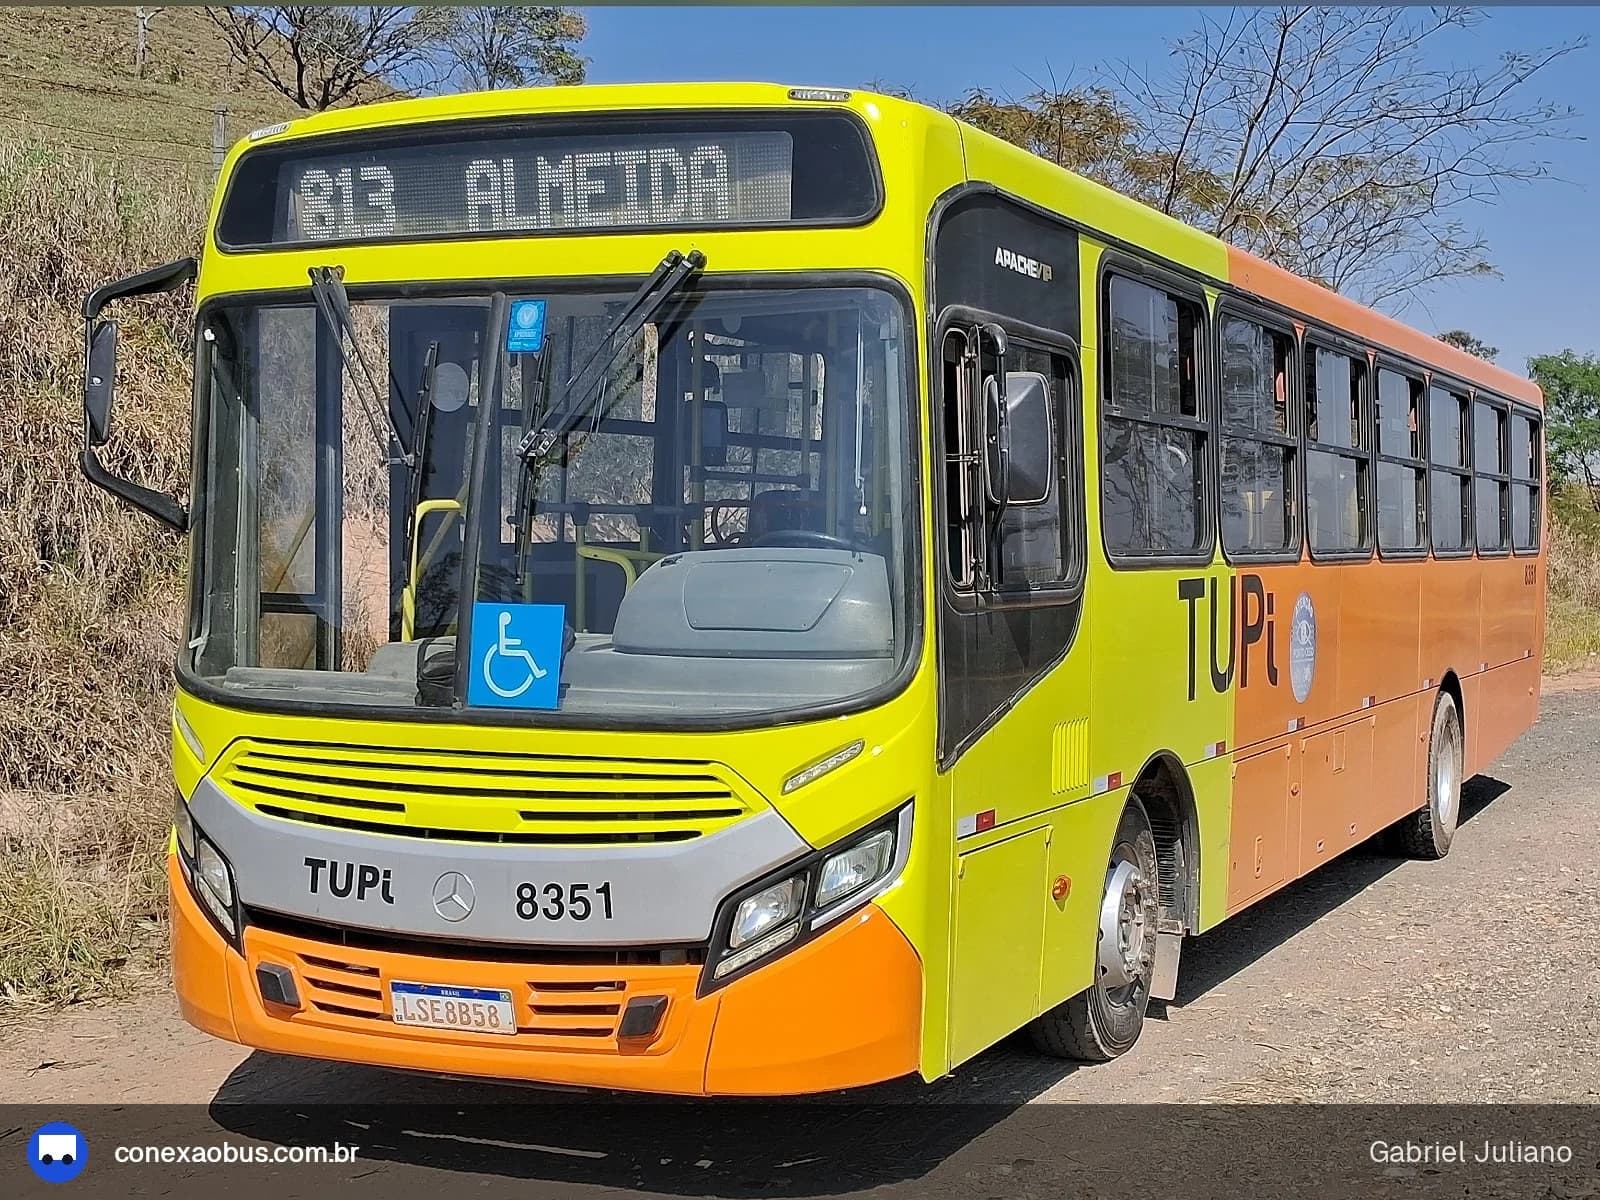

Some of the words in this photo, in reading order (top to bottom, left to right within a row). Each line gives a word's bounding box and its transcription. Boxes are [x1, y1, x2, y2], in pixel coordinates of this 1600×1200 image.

[300, 165, 396, 239] 813
[465, 145, 729, 232] ALMEIDA
[514, 881, 614, 921] 8351
[440, 989, 461, 997] BRASIL
[402, 997, 500, 1028] LSE8B58
